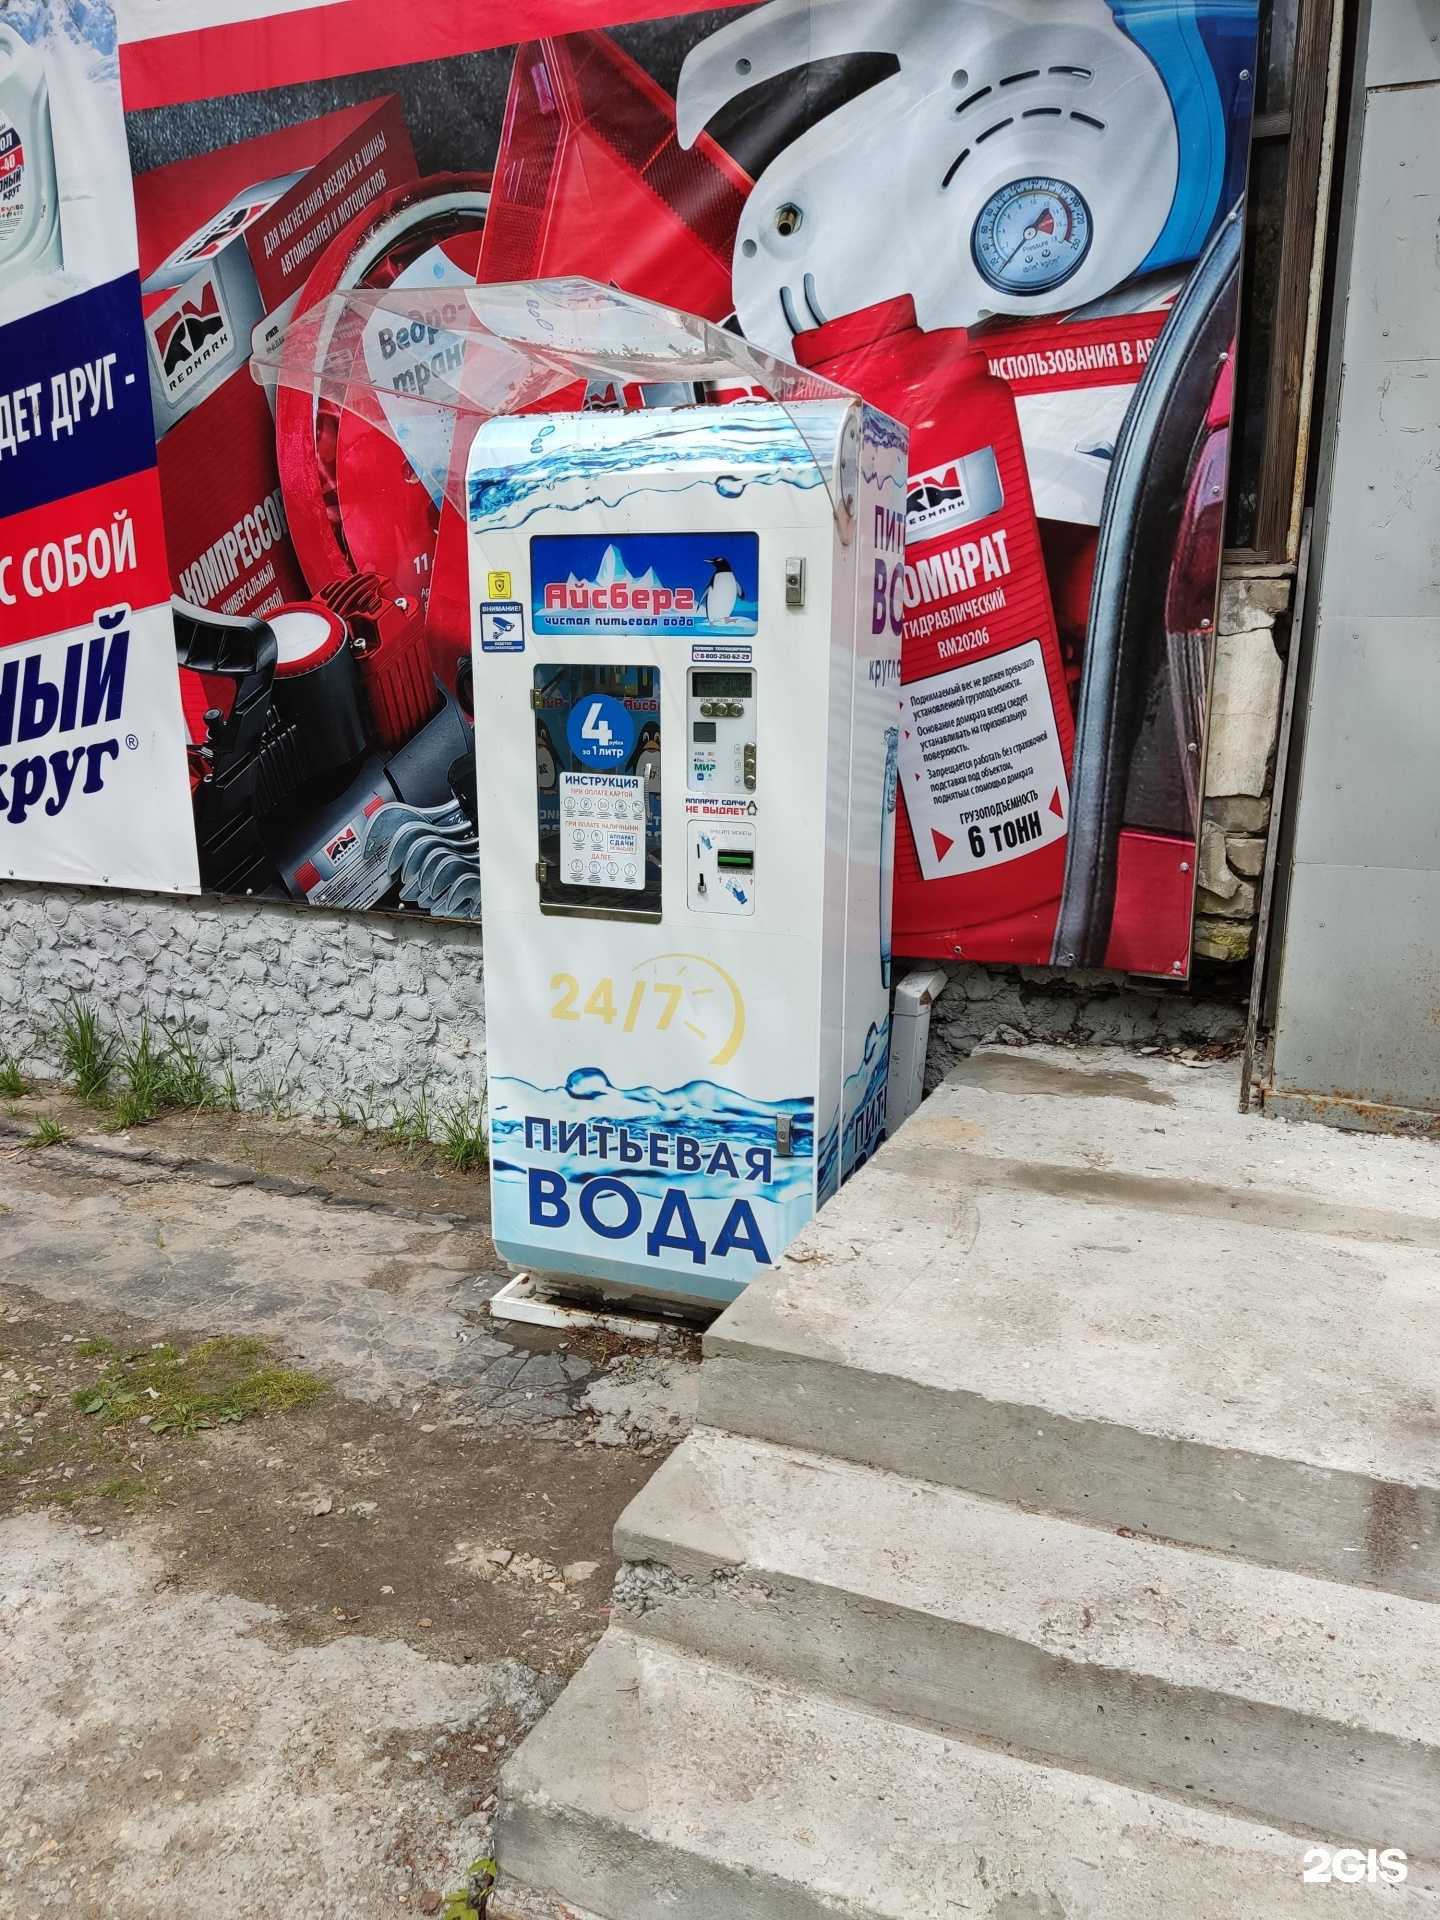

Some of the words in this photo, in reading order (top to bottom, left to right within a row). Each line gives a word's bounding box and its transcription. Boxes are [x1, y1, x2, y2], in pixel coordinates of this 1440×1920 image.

[263, 232, 280, 258] ДЛЯ
[280, 188, 325, 241] НАГНЕТАНИЯ
[323, 161, 355, 198] ВОЗДУХА
[355, 156, 362, 171] В
[361, 131, 387, 164] ШИНЫ
[280, 224, 329, 277] АВТОМОБИЛЕЙ
[331, 215, 340, 236] И
[340, 168, 387, 225] МОТОЦИКЛОВ
[392, 344, 466, 395] тран
[988, 343, 1119, 380] ИСПОЛЬЗОВАНИЯ
[1119, 341, 1133, 365] В
[51, 352, 117, 442] ДРУГ
[22, 507, 138, 598] СОБОЙ
[178, 487, 289, 609] КОМПРЕССОР
[903, 528, 1011, 609] ОМКРАТ
[482, 605, 521, 613] ВНИМАНИЕ!
[545, 583, 695, 616] Айсберг
[902, 585, 1007, 640] ГИДРАВЛИЧЕСКИЙ
[545, 616, 591, 627] чистая
[595, 616, 658, 627] питьевая
[663, 616, 694, 627] вода
[937, 626, 990, 659] RM20206
[910, 682, 961, 707] Поднимаемый
[961, 682, 973, 692] вес
[973, 678, 982, 687] не
[982, 671, 1006, 687] должен
[1005, 658, 1035, 679] превышать
[581, 703, 613, 745] 4
[913, 695, 965, 722] установленной
[917, 720, 955, 737] Основание
[956, 709, 987, 728] домкрата
[987, 703, 1007, 719] всегда
[1007, 693, 1029, 711] следует
[920, 728, 971, 753] устанавливать
[971, 725, 980, 735] на
[980, 708, 1028, 733] горизонтальную
[592, 745, 597, 756] 1
[599, 748, 624, 758] литр
[927, 757, 973, 780] Запрещается
[973, 750, 1002, 769] работать
[1001, 745, 1013, 758] без
[565, 775, 639, 789] ИНСТРУКЦИЯ
[686, 797, 719, 805] АППАРАТ
[930, 776, 967, 793] подставки
[968, 771, 981, 783] под
[933, 787, 970, 805] поднятым
[975, 777, 1006, 794] помощью
[1006, 766, 1034, 785] домкрата
[703, 806, 746, 815] ВЫДАЕТ
[959, 789, 1039, 825] ГРУЗОПОДЪЕМНОСТЬ
[968, 825, 986, 858] 6
[550, 972, 684, 1033] 24/7
[524, 1115, 772, 1184] ПИТЬЕВАЯ
[528, 1168, 772, 1266] ВОДА
